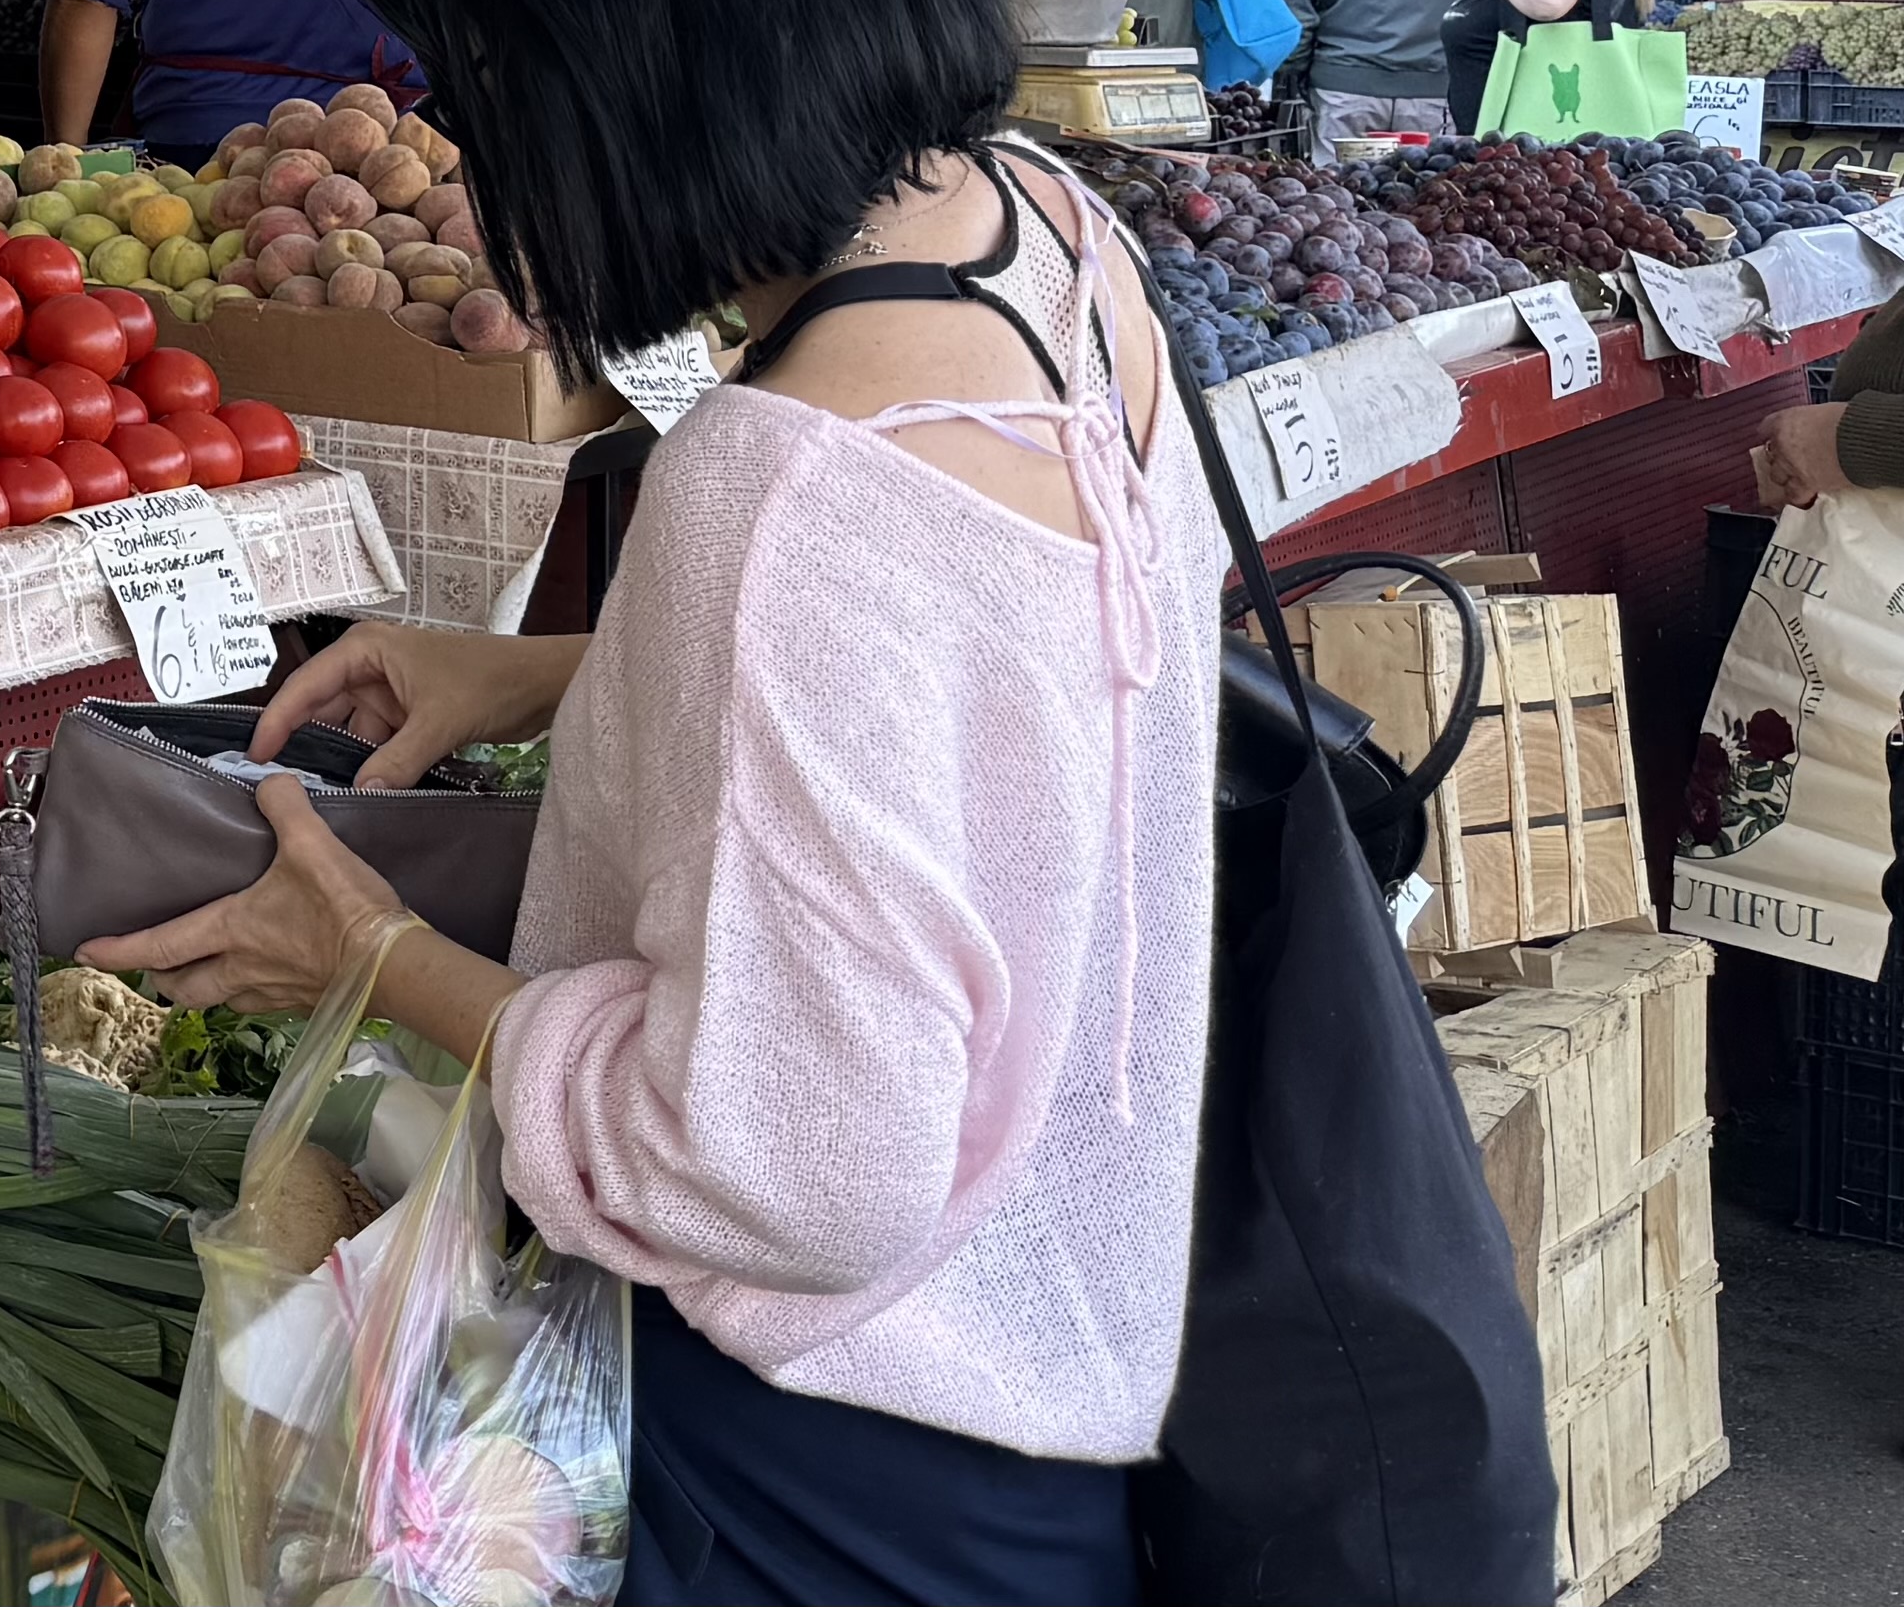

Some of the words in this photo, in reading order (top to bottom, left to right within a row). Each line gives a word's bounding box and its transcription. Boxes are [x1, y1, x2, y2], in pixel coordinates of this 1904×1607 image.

[1284, 413, 1314, 483] 5
[152, 605, 182, 698] 6
[1787, 615, 1827, 721] BEAUTIFUL
